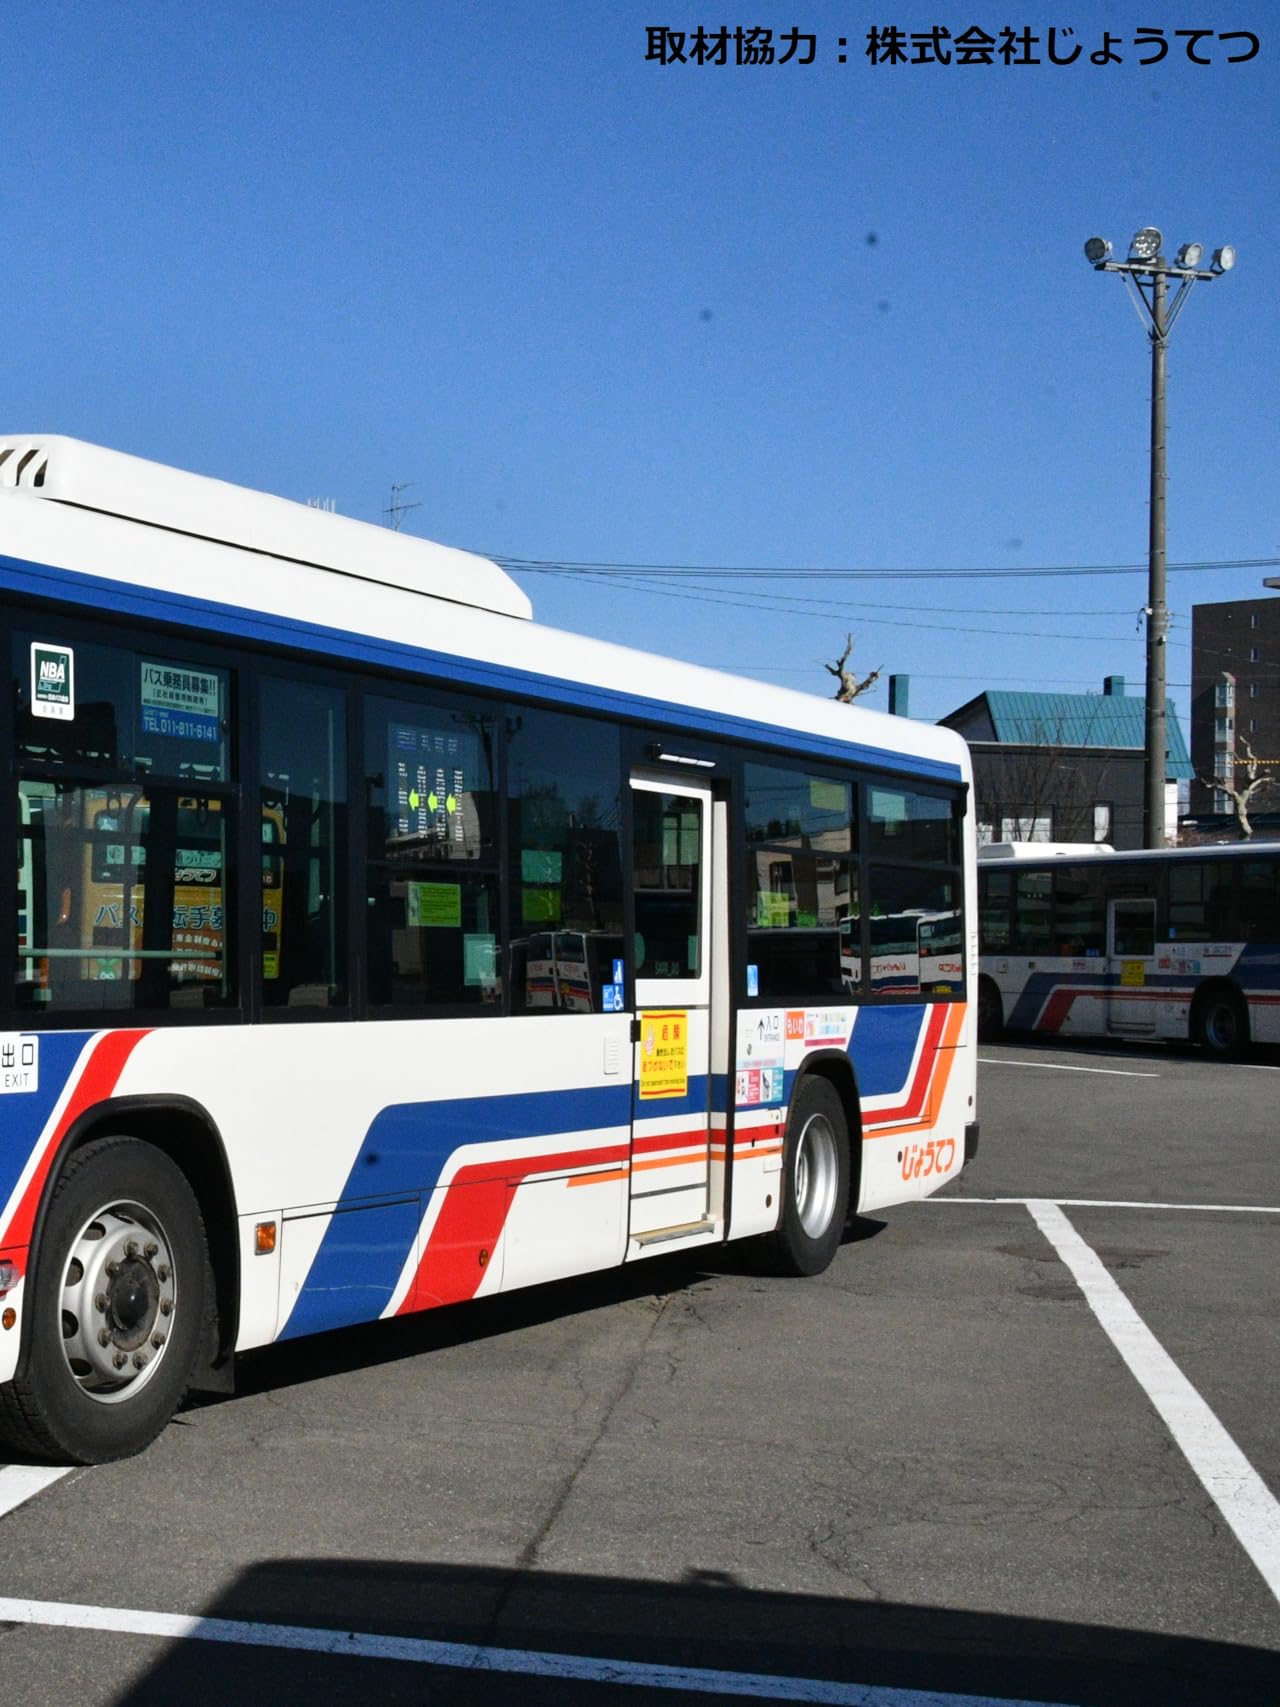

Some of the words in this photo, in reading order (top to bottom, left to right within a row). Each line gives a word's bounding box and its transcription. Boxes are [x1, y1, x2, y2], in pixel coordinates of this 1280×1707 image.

[40, 661, 65, 680] NBA
[2, 1042, 34, 1068] 出口
[4, 1073, 29, 1088] EXIT
[902, 1138, 955, 1181] じょうてつ
